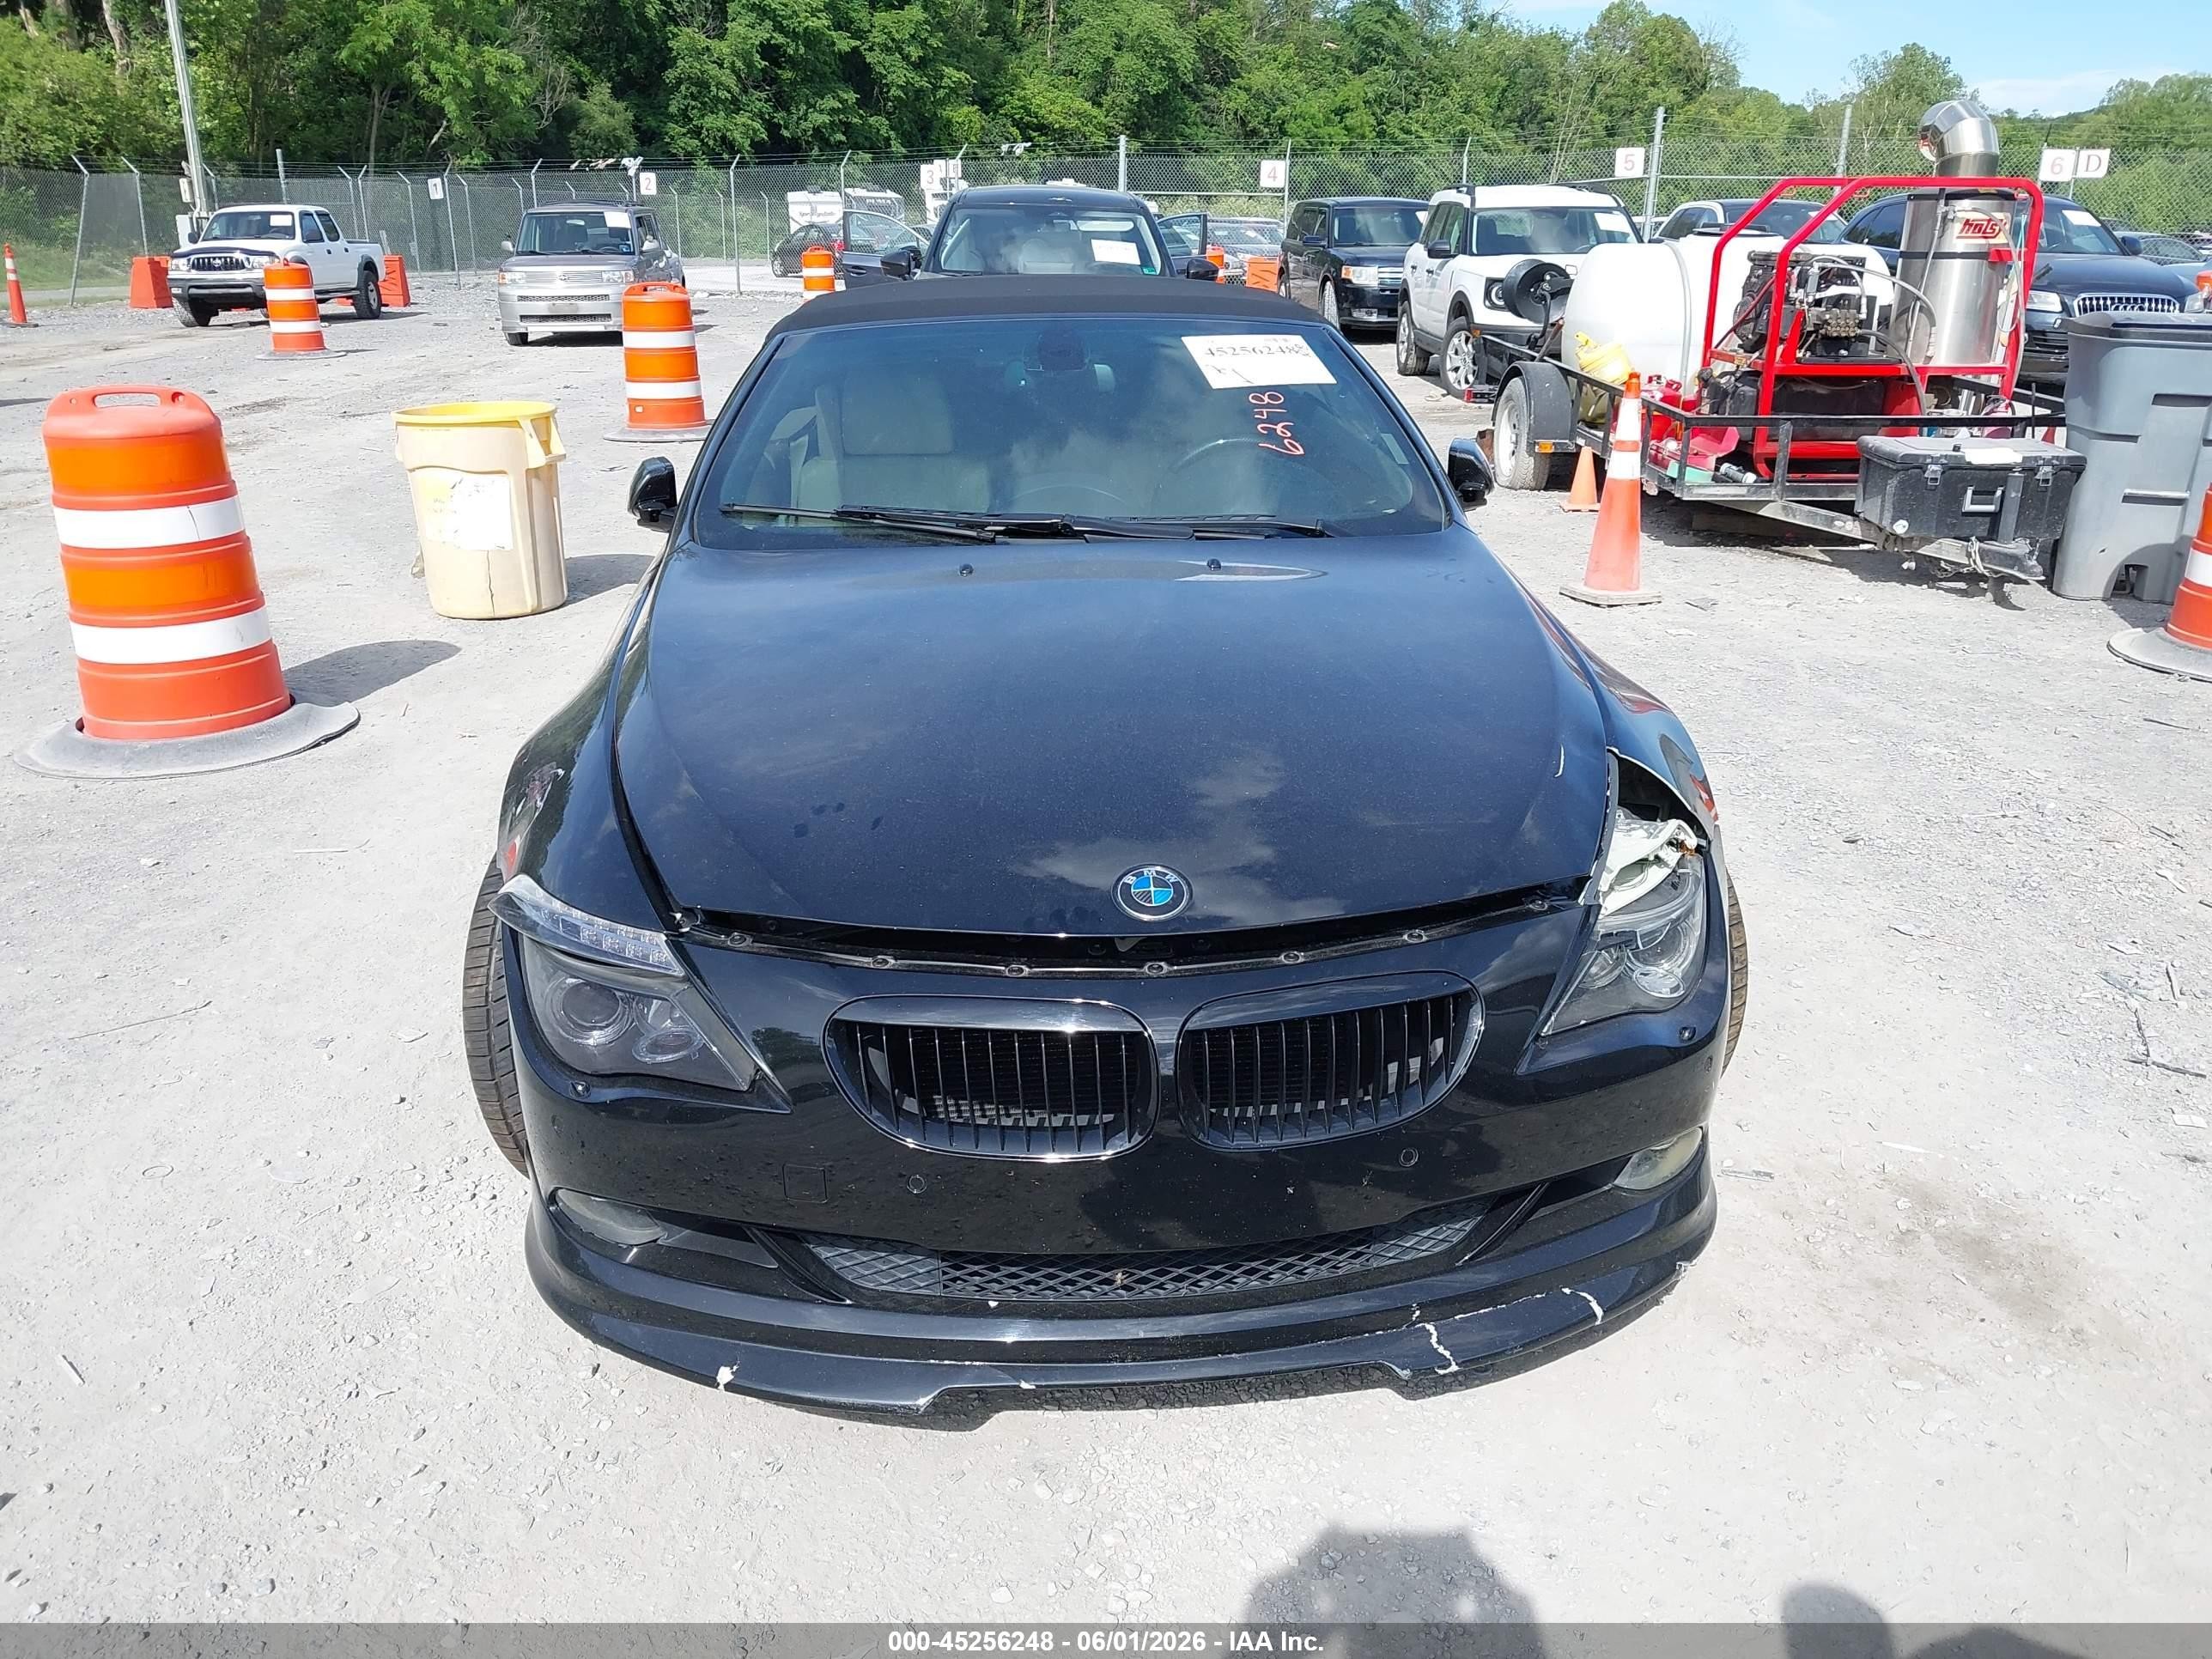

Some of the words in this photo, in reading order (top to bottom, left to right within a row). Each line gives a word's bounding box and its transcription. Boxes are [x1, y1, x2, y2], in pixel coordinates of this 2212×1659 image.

[1624, 154, 1636, 172] 5
[2051, 156, 2064, 175] 6
[2084, 154, 2102, 173] D
[927, 169, 934, 185] 3
[1267, 166, 1278, 182] 4
[433, 183, 439, 195] 1
[644, 177, 652, 191] 2
[1249, 392, 1305, 456] 6248
[1123, 869, 1179, 885] BMW
